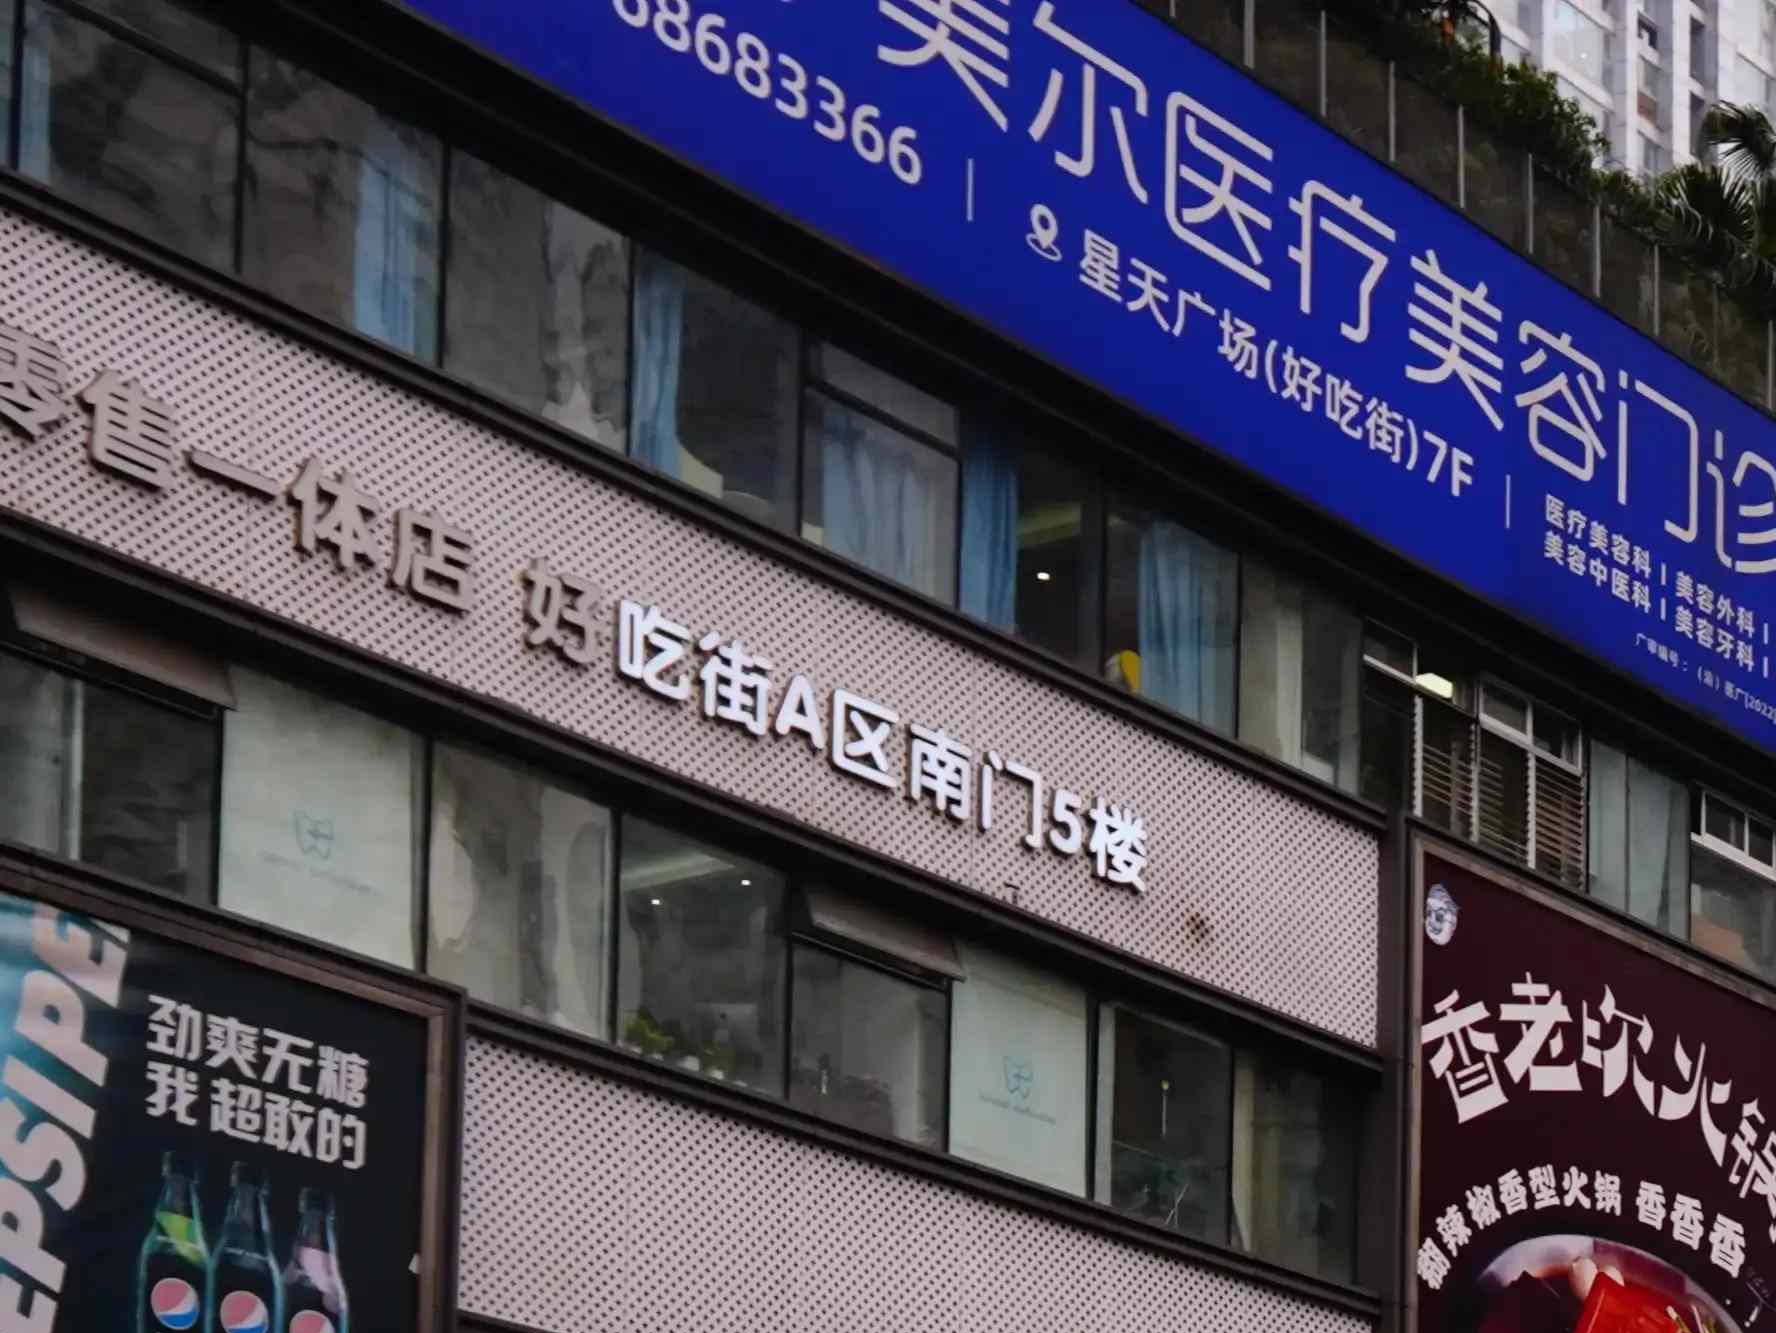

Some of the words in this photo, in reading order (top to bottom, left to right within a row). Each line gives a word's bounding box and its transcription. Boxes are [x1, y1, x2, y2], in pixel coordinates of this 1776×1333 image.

[1079, 228, 1474, 498] 星天广场(好吃街)7F
[1543, 530, 1652, 615] 美容中医科
[1674, 605, 1755, 673] 美容牙科
[1544, 493, 1652, 580] 医疗美容科
[1675, 570, 1755, 639] 美容外科
[519, 556, 1147, 893] 好吃街A区南门5楼
[144, 993, 371, 1109] 劲爽无糖
